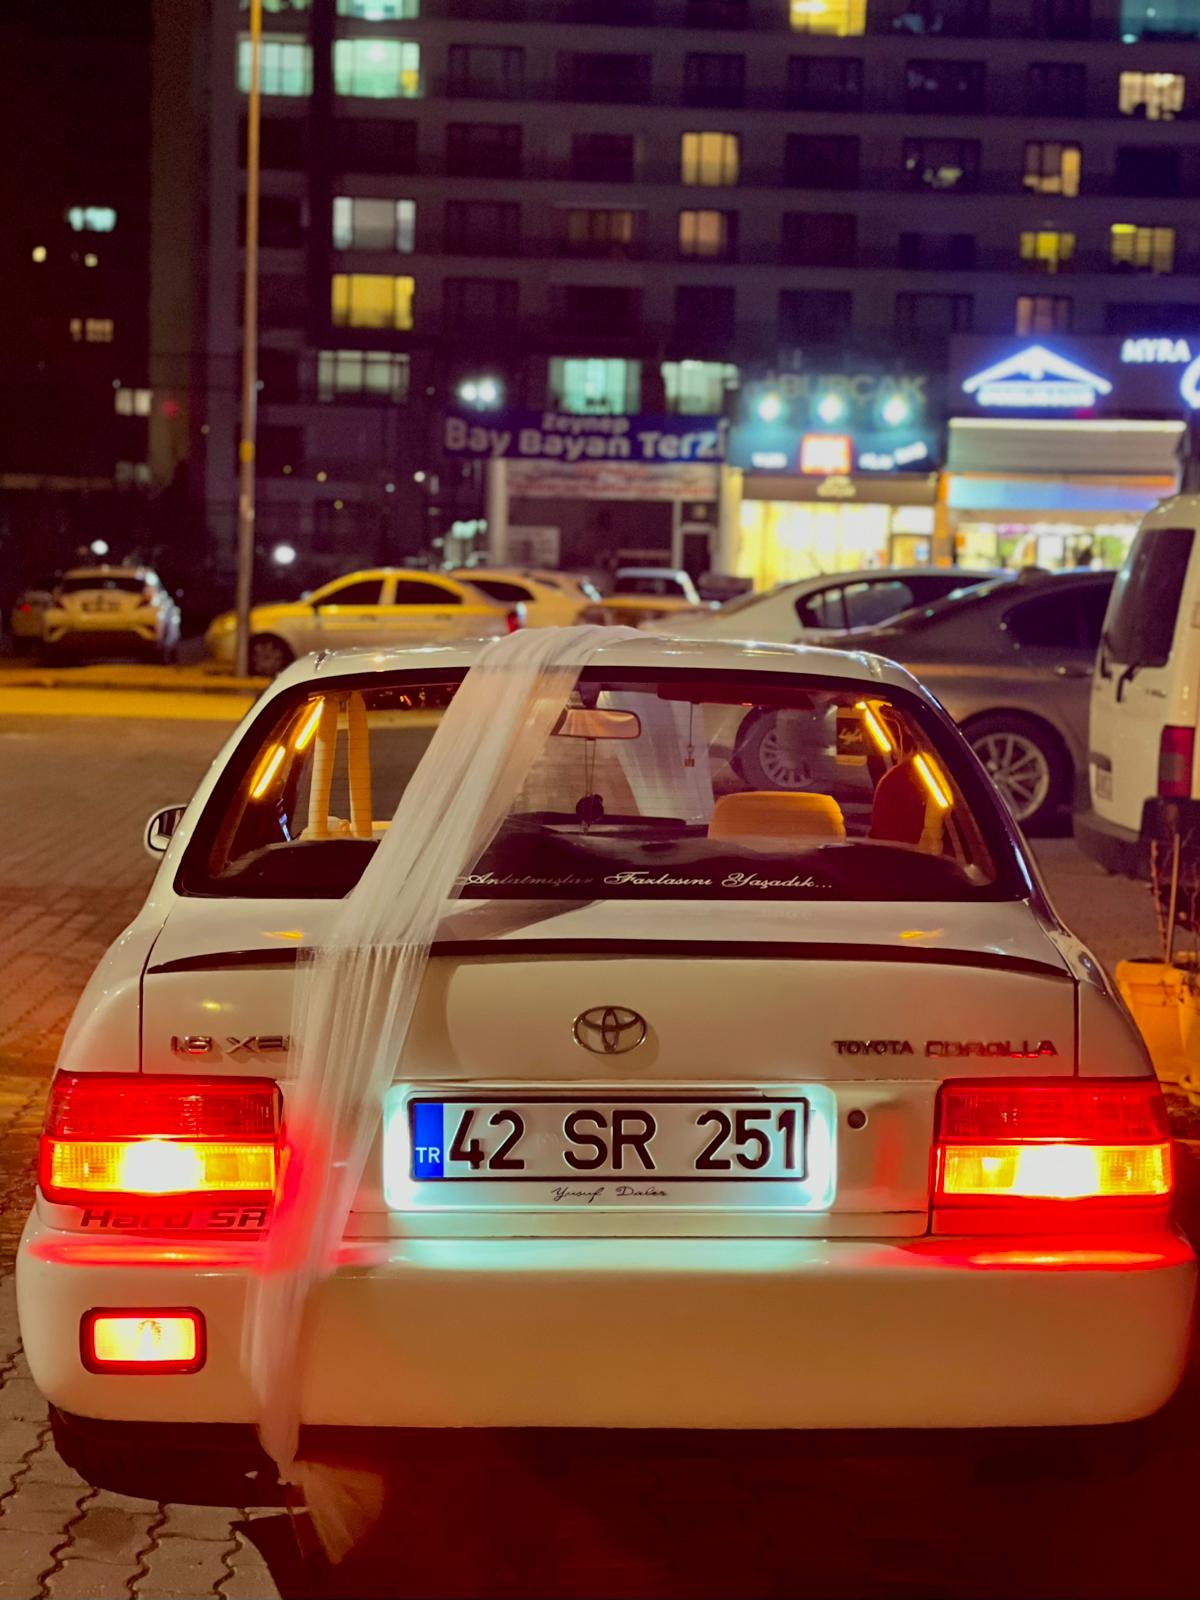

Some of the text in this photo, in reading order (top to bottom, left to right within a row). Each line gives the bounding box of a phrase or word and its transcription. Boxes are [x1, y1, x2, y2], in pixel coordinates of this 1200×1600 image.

[1121, 338, 1191, 363] MYRA
[445, 418, 729, 460] Bay Bayan Terzi
[834, 1040, 1059, 1058] TOYOTA COROLLA
[448, 1110, 798, 1170] 42 SR 251
[415, 1147, 440, 1163] TR
[80, 1209, 193, 1228] Hard
